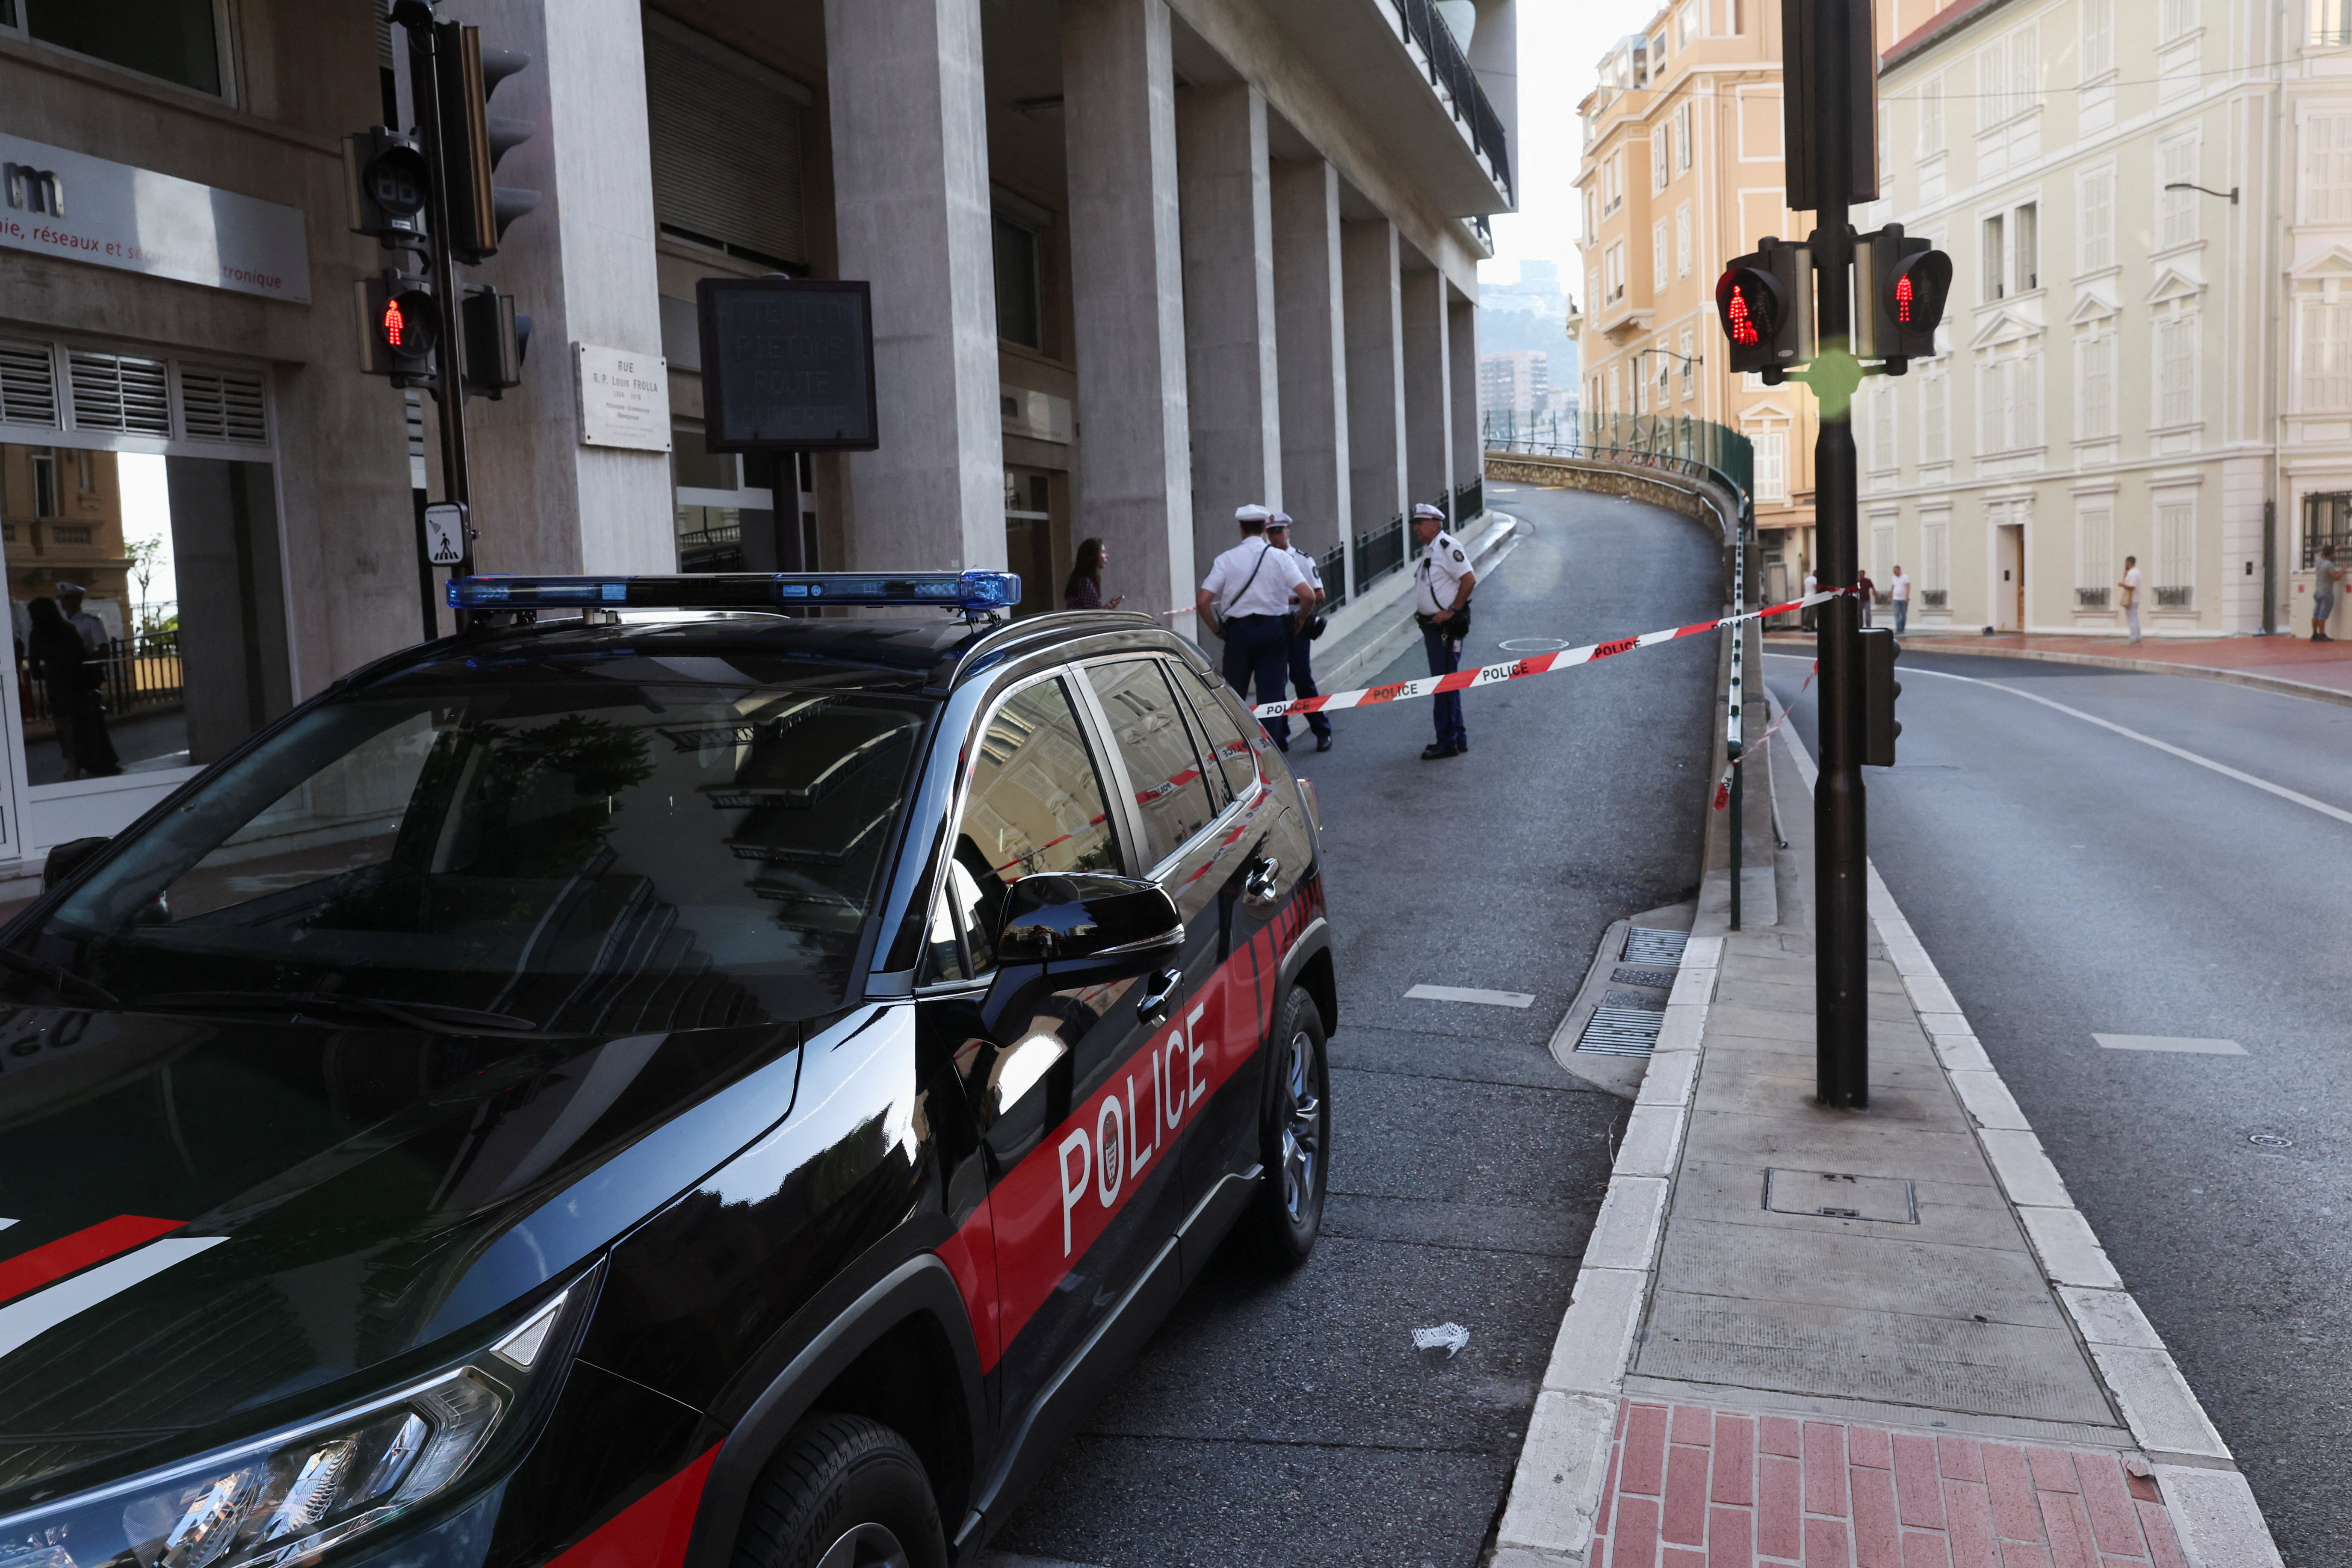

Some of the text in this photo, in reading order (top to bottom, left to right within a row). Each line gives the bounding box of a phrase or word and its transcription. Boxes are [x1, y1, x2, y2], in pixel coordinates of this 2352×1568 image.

[33, 226, 100, 252] réseaux
[106, 242, 121, 257] et
[618, 360, 633, 373] RUE
[633, 379, 658, 393] FROLLA
[754, 371, 831, 395] ROUTE
[1594, 640, 1641, 658] POLICE
[1483, 662, 1529, 682] POLICE
[1373, 684, 1418, 700] POLICE
[1266, 700, 1310, 715] POLICE
[1716, 776, 1732, 807] POLICE
[1058, 1002, 1206, 1258] POLICE
